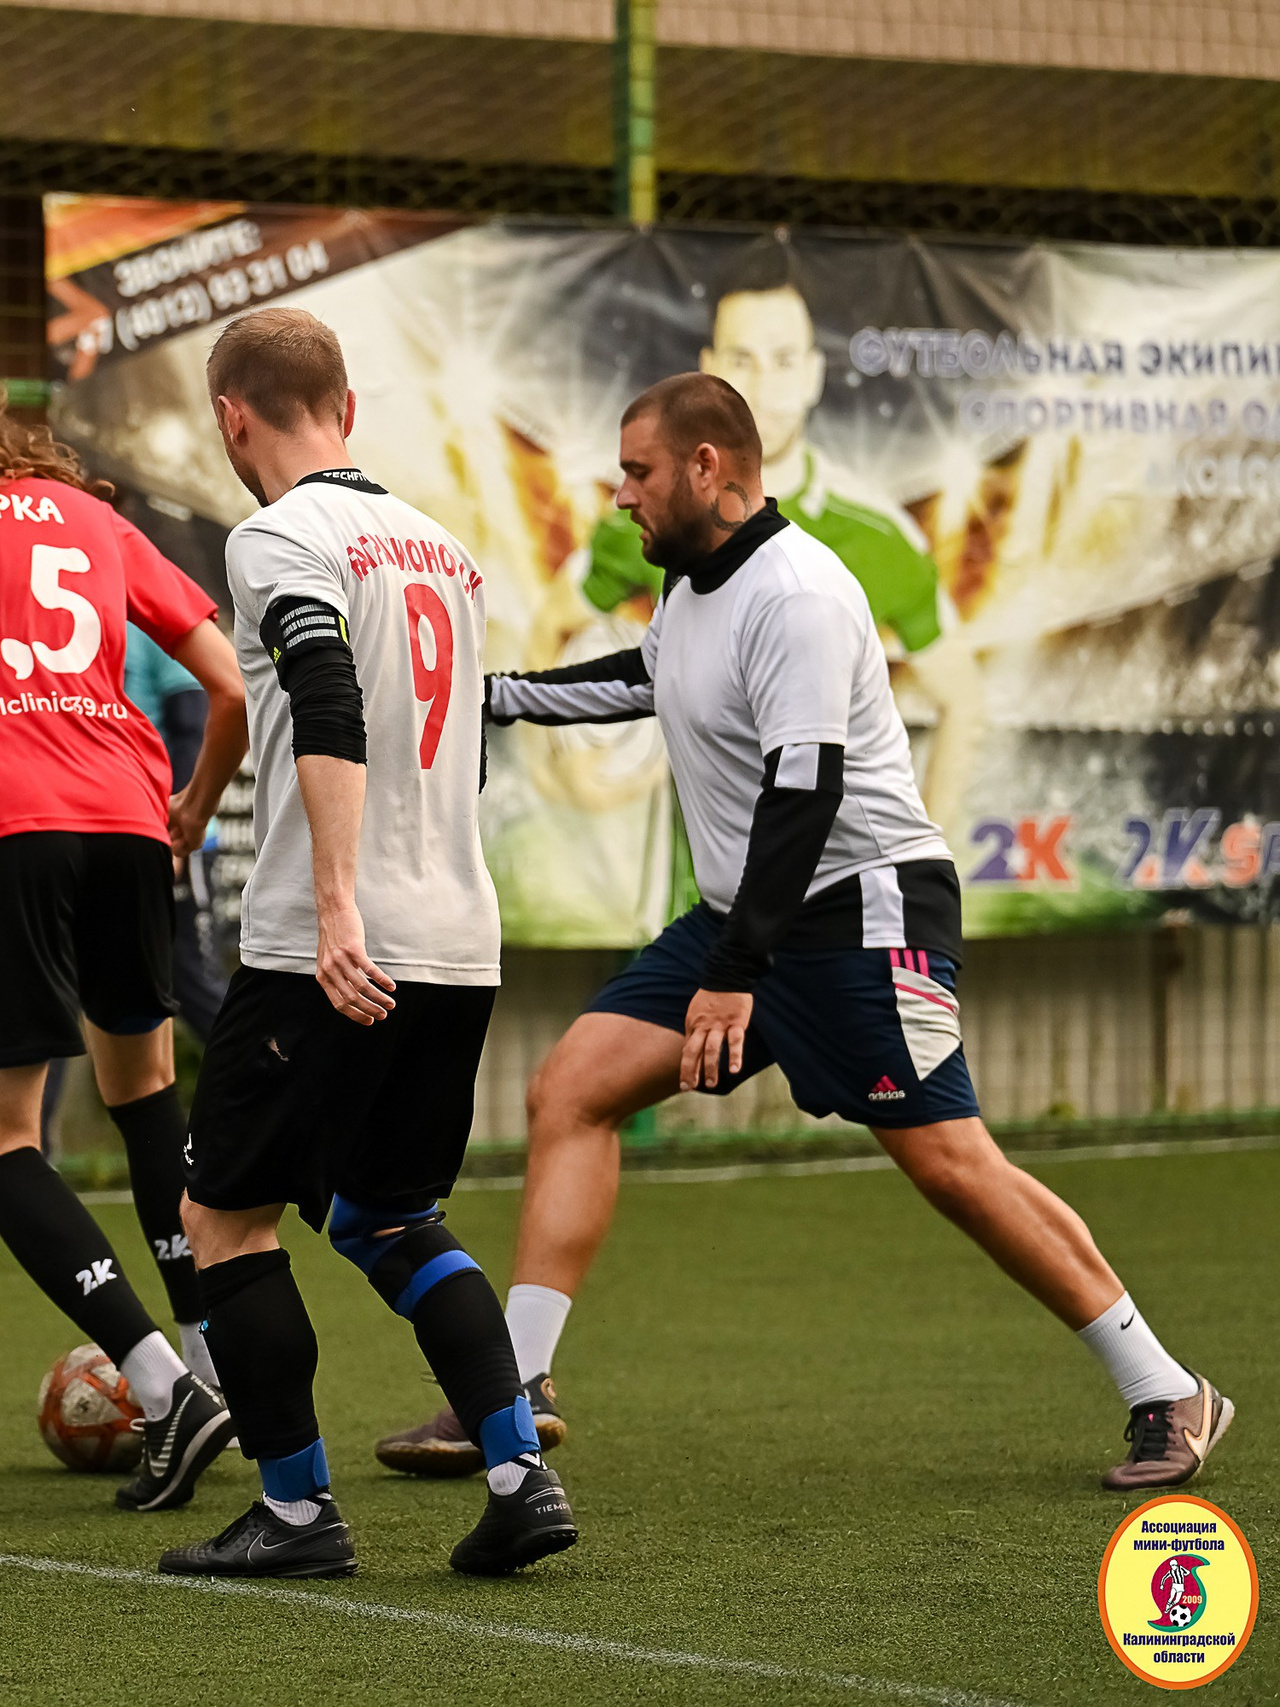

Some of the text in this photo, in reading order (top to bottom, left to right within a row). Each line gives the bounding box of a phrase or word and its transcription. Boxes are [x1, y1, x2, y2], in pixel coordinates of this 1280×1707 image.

[850, 327, 1280, 378] ФУТБОЛЬНАЯ ЭКИПИ
[960, 392, 1227, 436] СПОРТИВНАЯ
[322, 471, 367, 482] TECHFI
[403, 582, 454, 770] 9
[967, 814, 1075, 884] 2K
[868, 1089, 905, 1100] adidas
[154, 1234, 192, 1260] 2K
[76, 1258, 118, 1296] 2K
